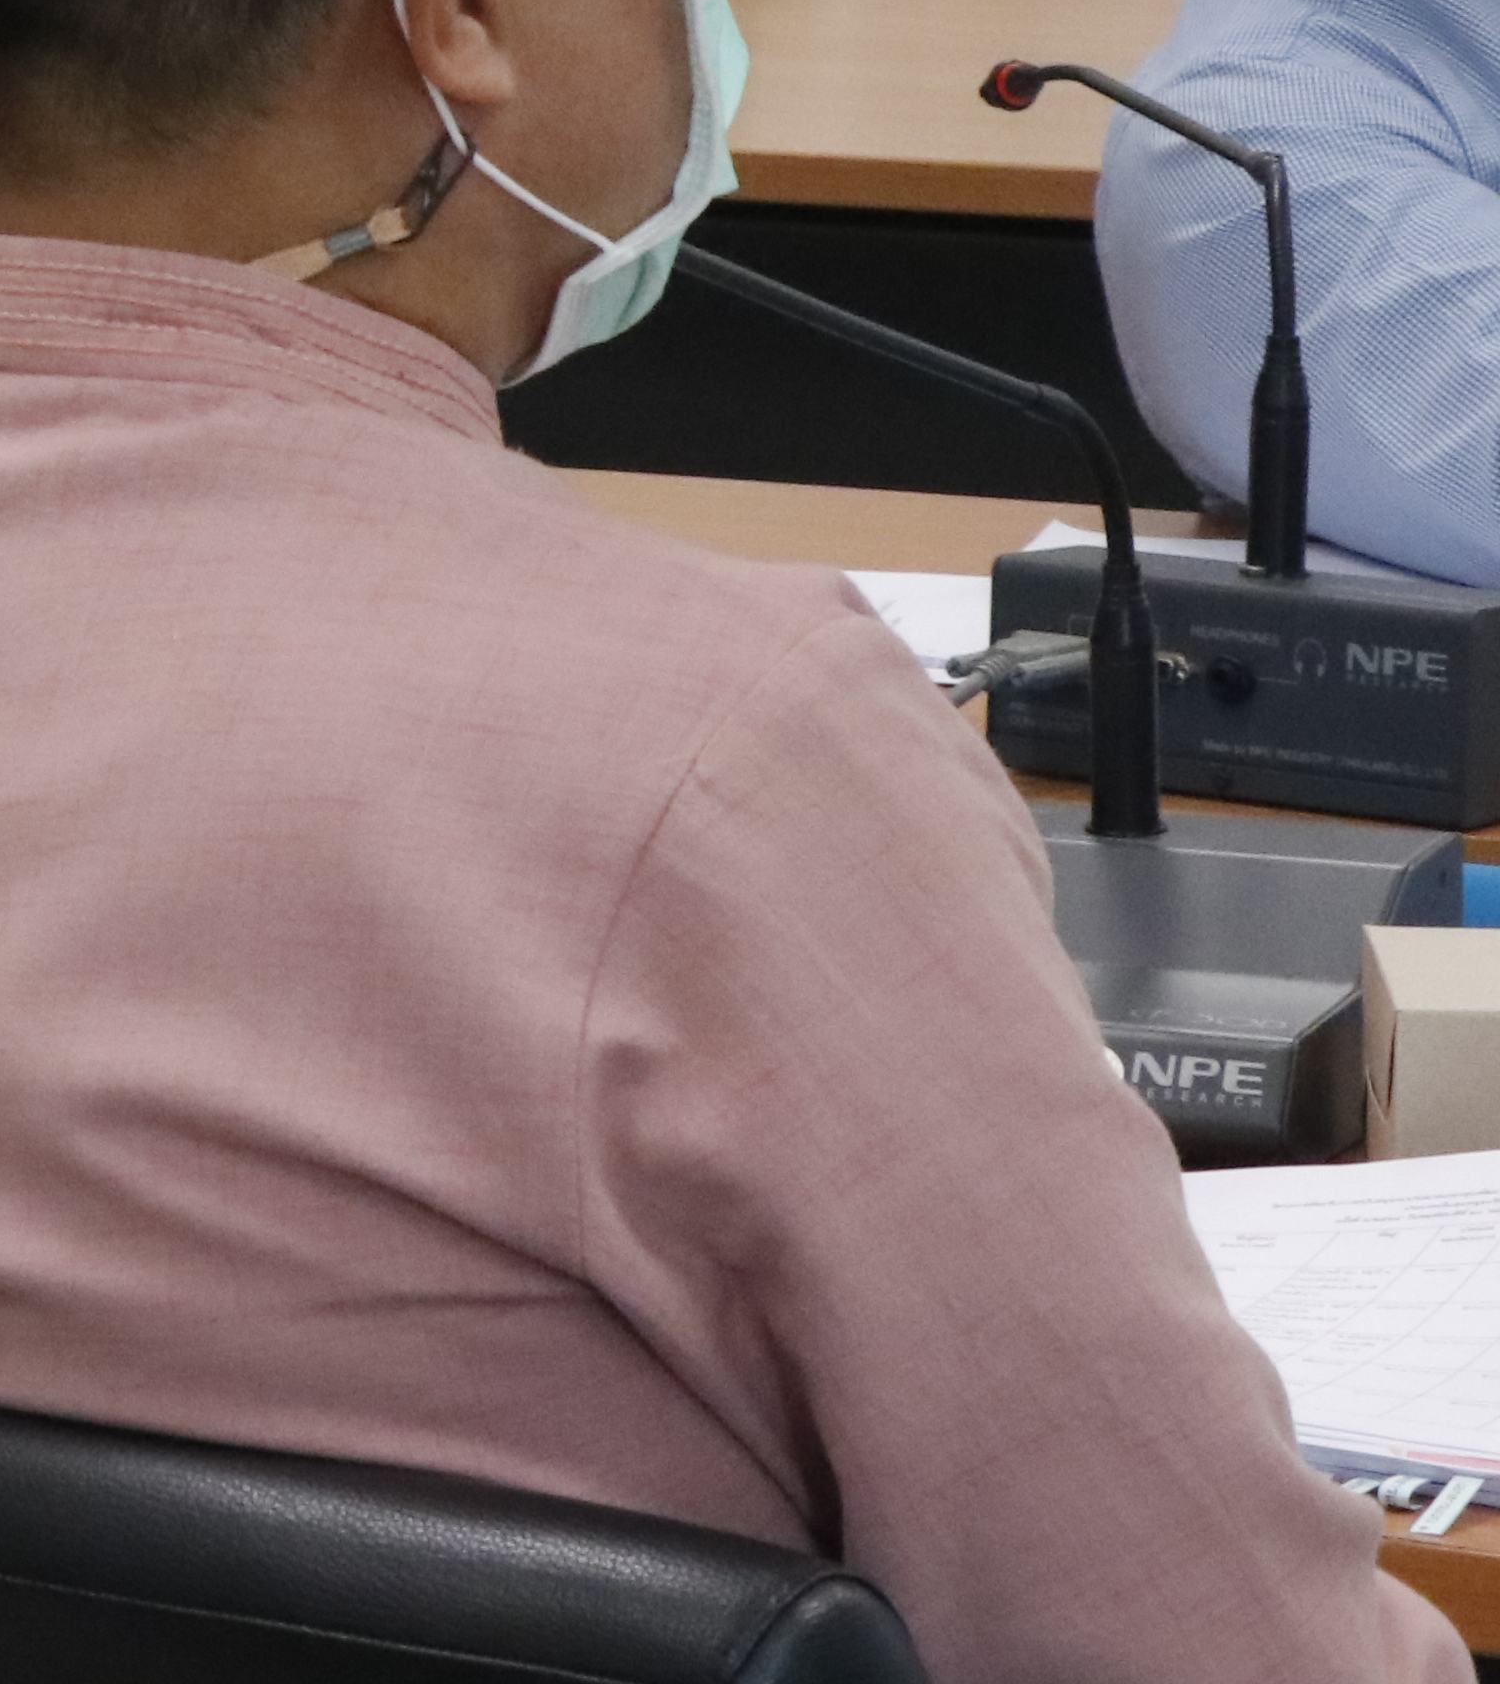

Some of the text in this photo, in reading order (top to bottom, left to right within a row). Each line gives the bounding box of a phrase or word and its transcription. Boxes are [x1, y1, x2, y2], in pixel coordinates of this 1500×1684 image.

[1345, 641, 1450, 684] NPE
[1131, 1050, 1267, 1097] NPE
[1145, 1086, 1264, 1109] ESEARCH
